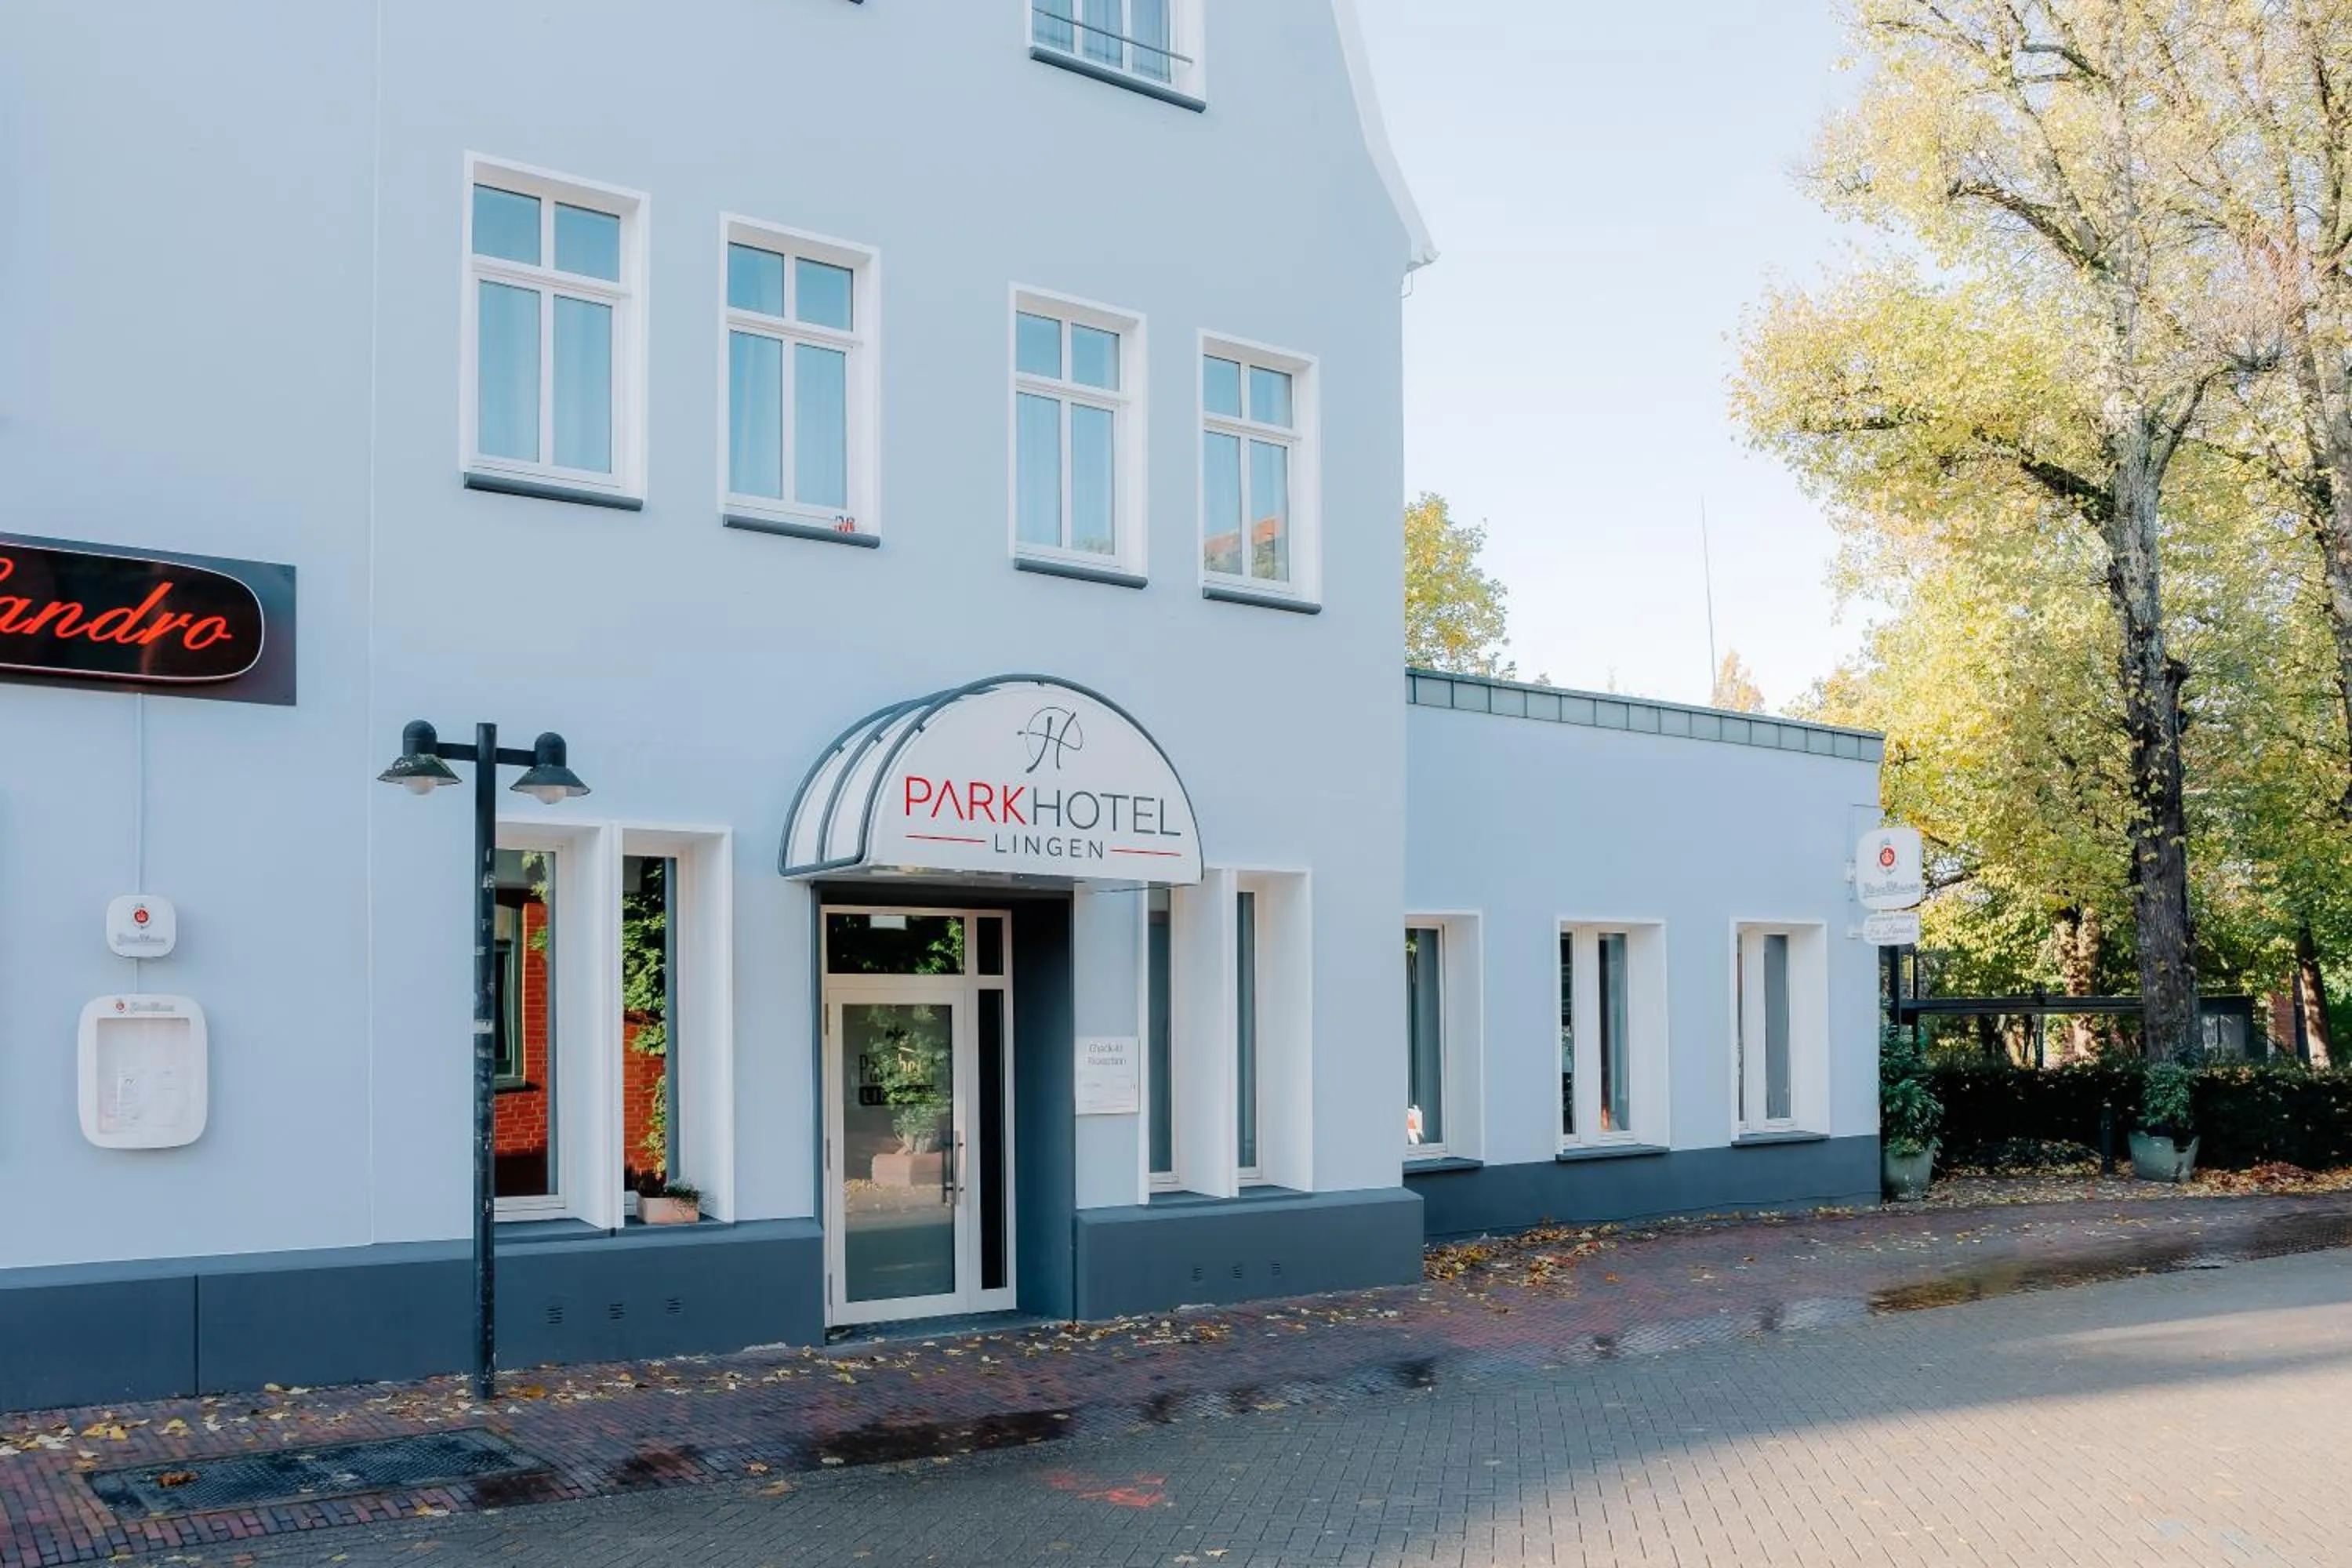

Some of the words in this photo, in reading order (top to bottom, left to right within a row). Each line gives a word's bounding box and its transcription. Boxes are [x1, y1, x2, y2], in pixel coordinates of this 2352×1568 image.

[0, 557, 232, 650] andro
[906, 776, 1181, 837] PARKHOTEL
[995, 833, 1104, 860] LINGEN
